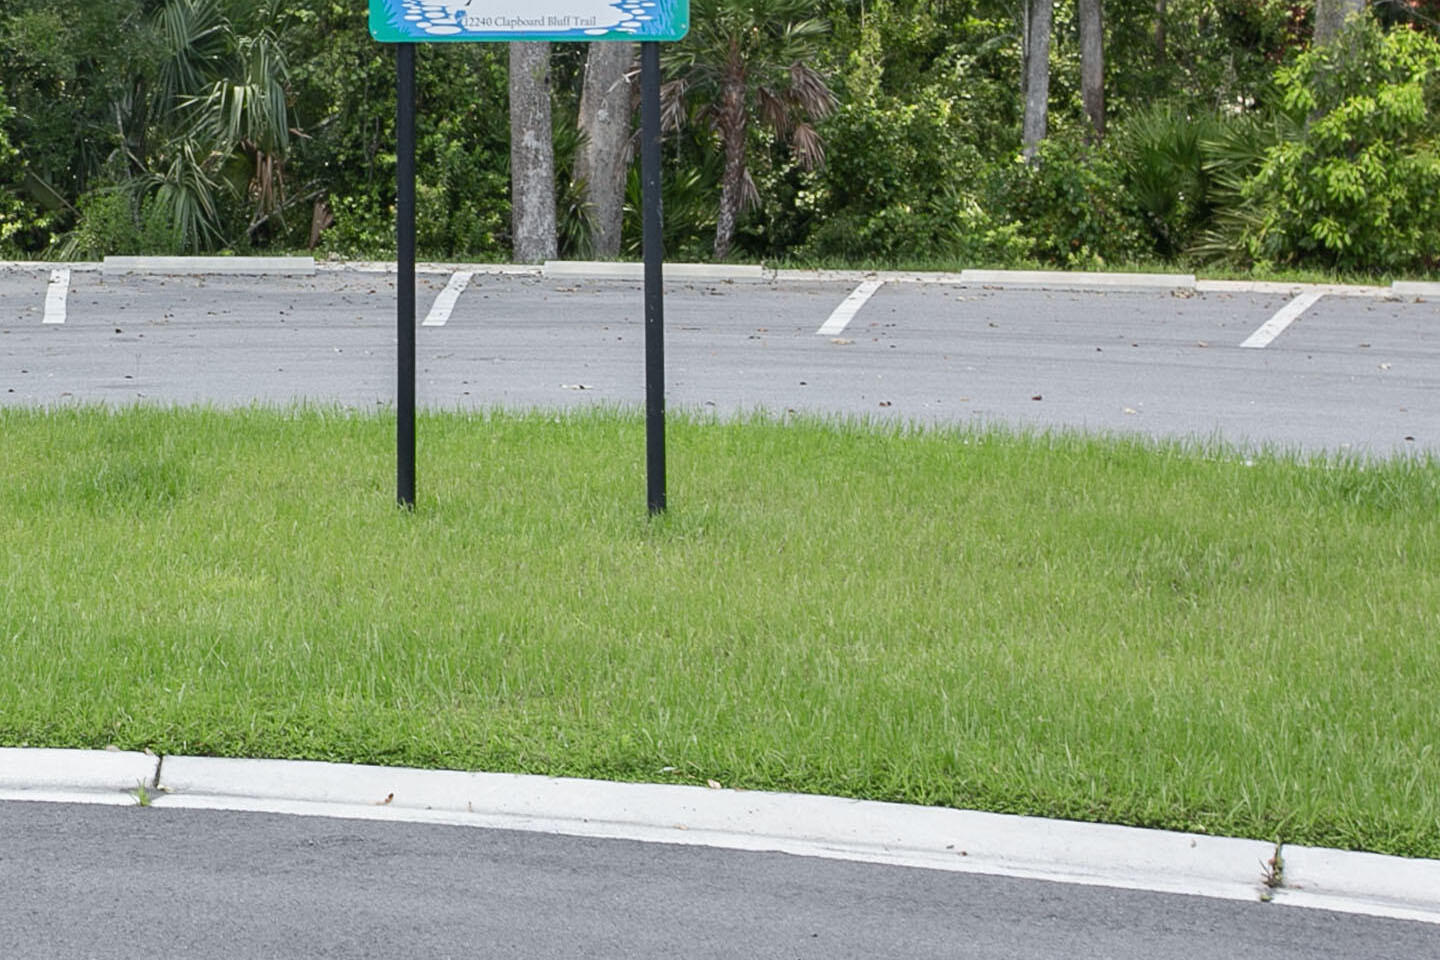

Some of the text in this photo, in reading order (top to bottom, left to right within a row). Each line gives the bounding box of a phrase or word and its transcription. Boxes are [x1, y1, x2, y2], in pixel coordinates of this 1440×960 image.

[465, 15, 596, 29] 12240 Clapboard Bluff Trail
